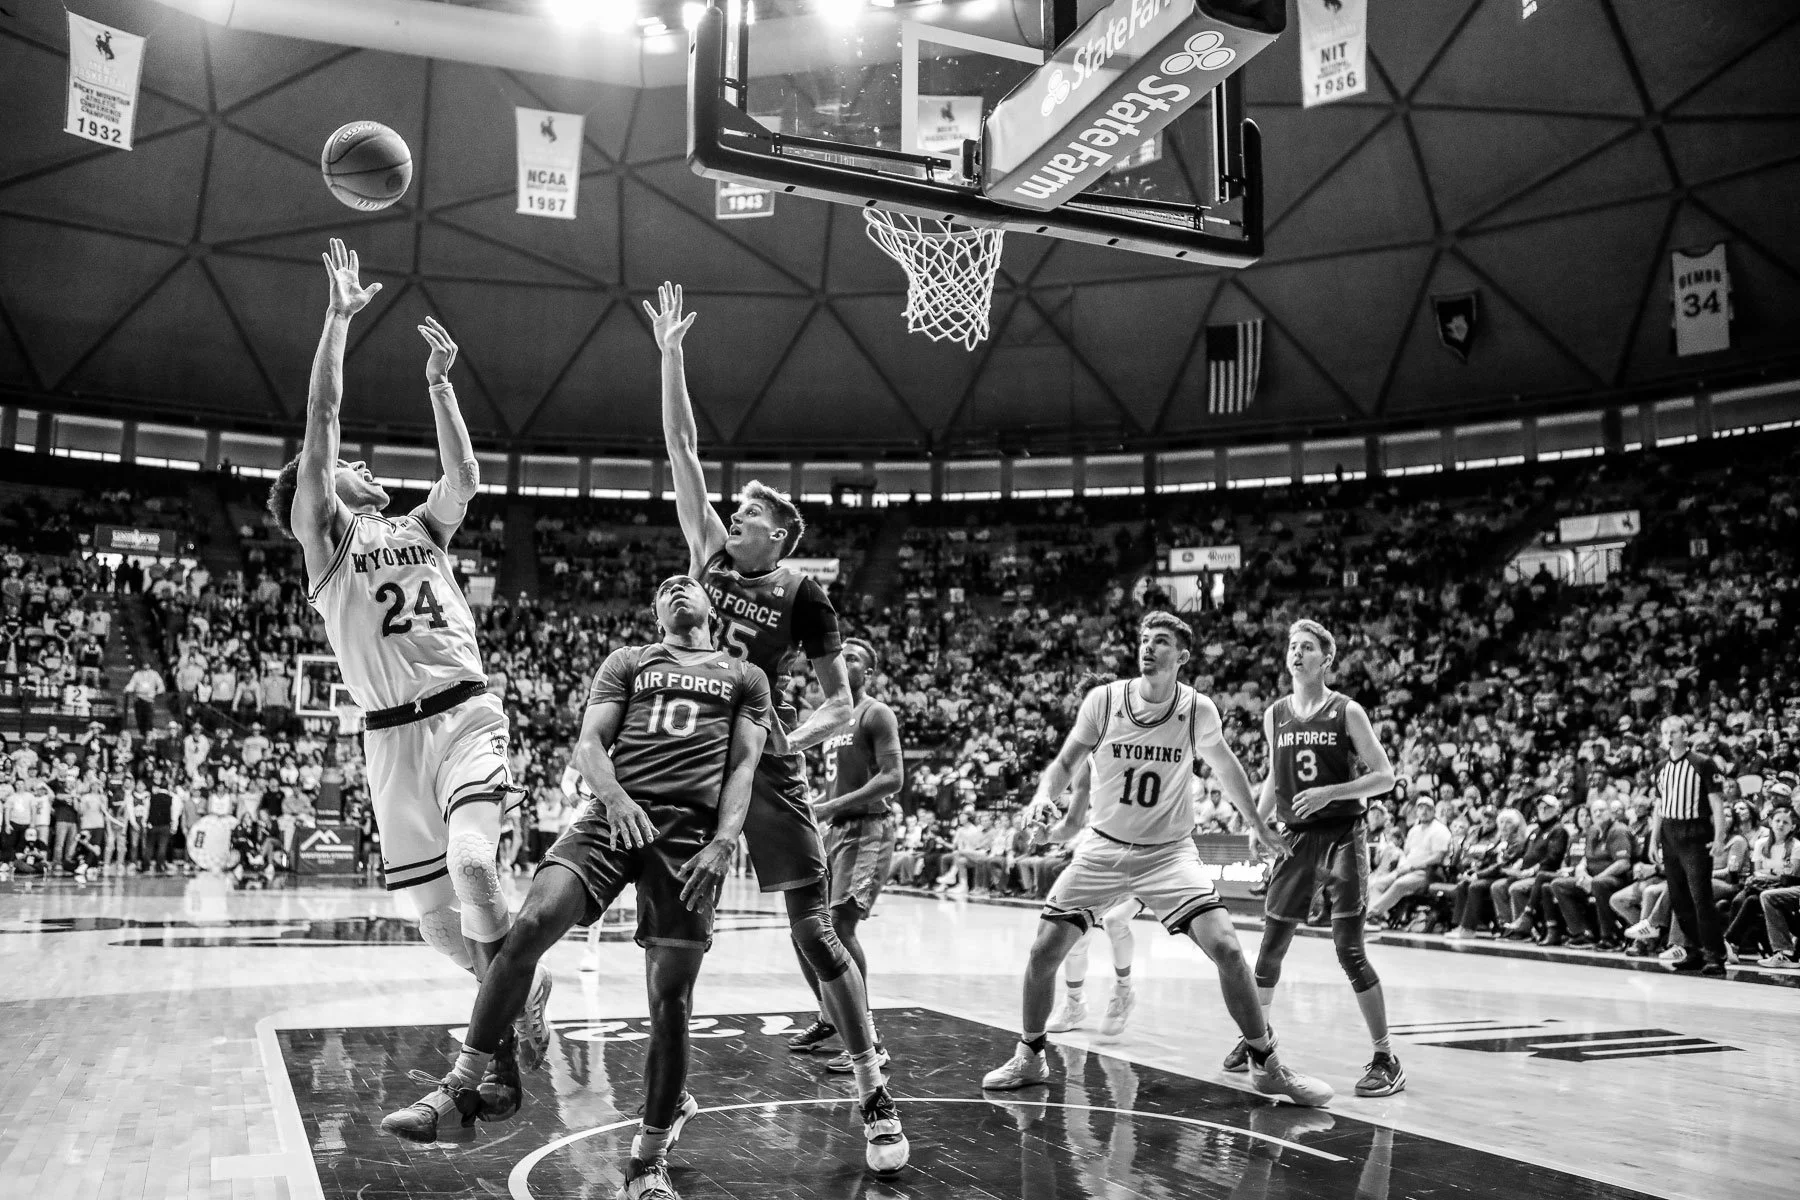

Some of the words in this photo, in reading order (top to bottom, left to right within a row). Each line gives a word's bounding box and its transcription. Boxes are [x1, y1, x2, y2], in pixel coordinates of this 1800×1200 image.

[1072, 0, 1171, 90] StateFa
[1321, 42, 1347, 63] NIT
[1315, 71, 1356, 98] 1986
[77, 117, 121, 143] 1932
[527, 169, 566, 186] NCAA
[528, 196, 566, 211] 1987
[1683, 290, 1721, 318] 34
[352, 545, 437, 573] WYOMING
[375, 580, 448, 637] 24
[722, 595, 782, 628] FORCE
[634, 671, 663, 693] AIR
[666, 673, 735, 701] FORCE
[647, 694, 701, 737] 10
[1112, 743, 1182, 764] WYOMING
[1277, 732, 1295, 748] AIR
[1296, 731, 1338, 746] FORCE
[825, 752, 838, 782] 5
[1295, 749, 1318, 782] 3
[1119, 767, 1161, 808] 10
